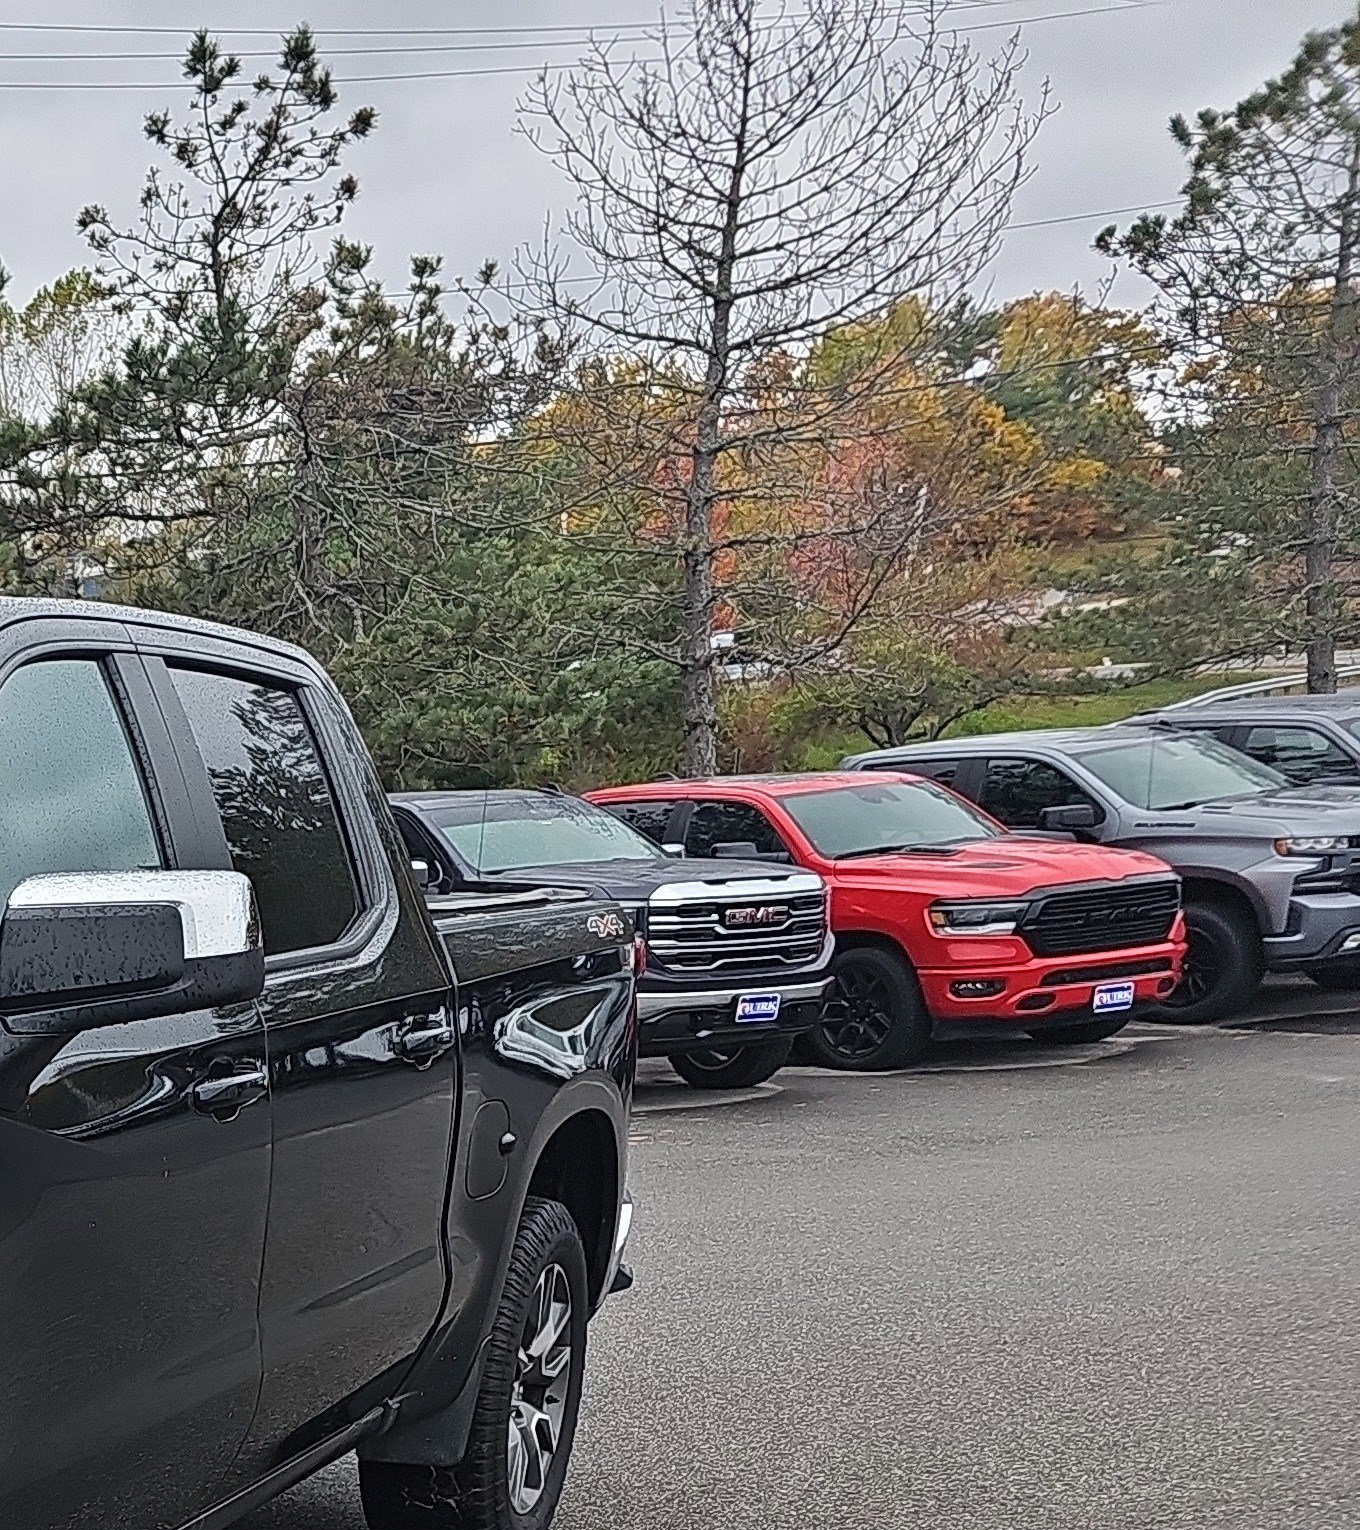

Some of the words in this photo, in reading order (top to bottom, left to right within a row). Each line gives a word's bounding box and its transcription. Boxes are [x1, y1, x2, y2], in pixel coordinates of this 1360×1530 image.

[725, 906, 788, 925] GMC
[587, 914, 625, 938] 4X4
[740, 1001, 777, 1015] QUIRK
